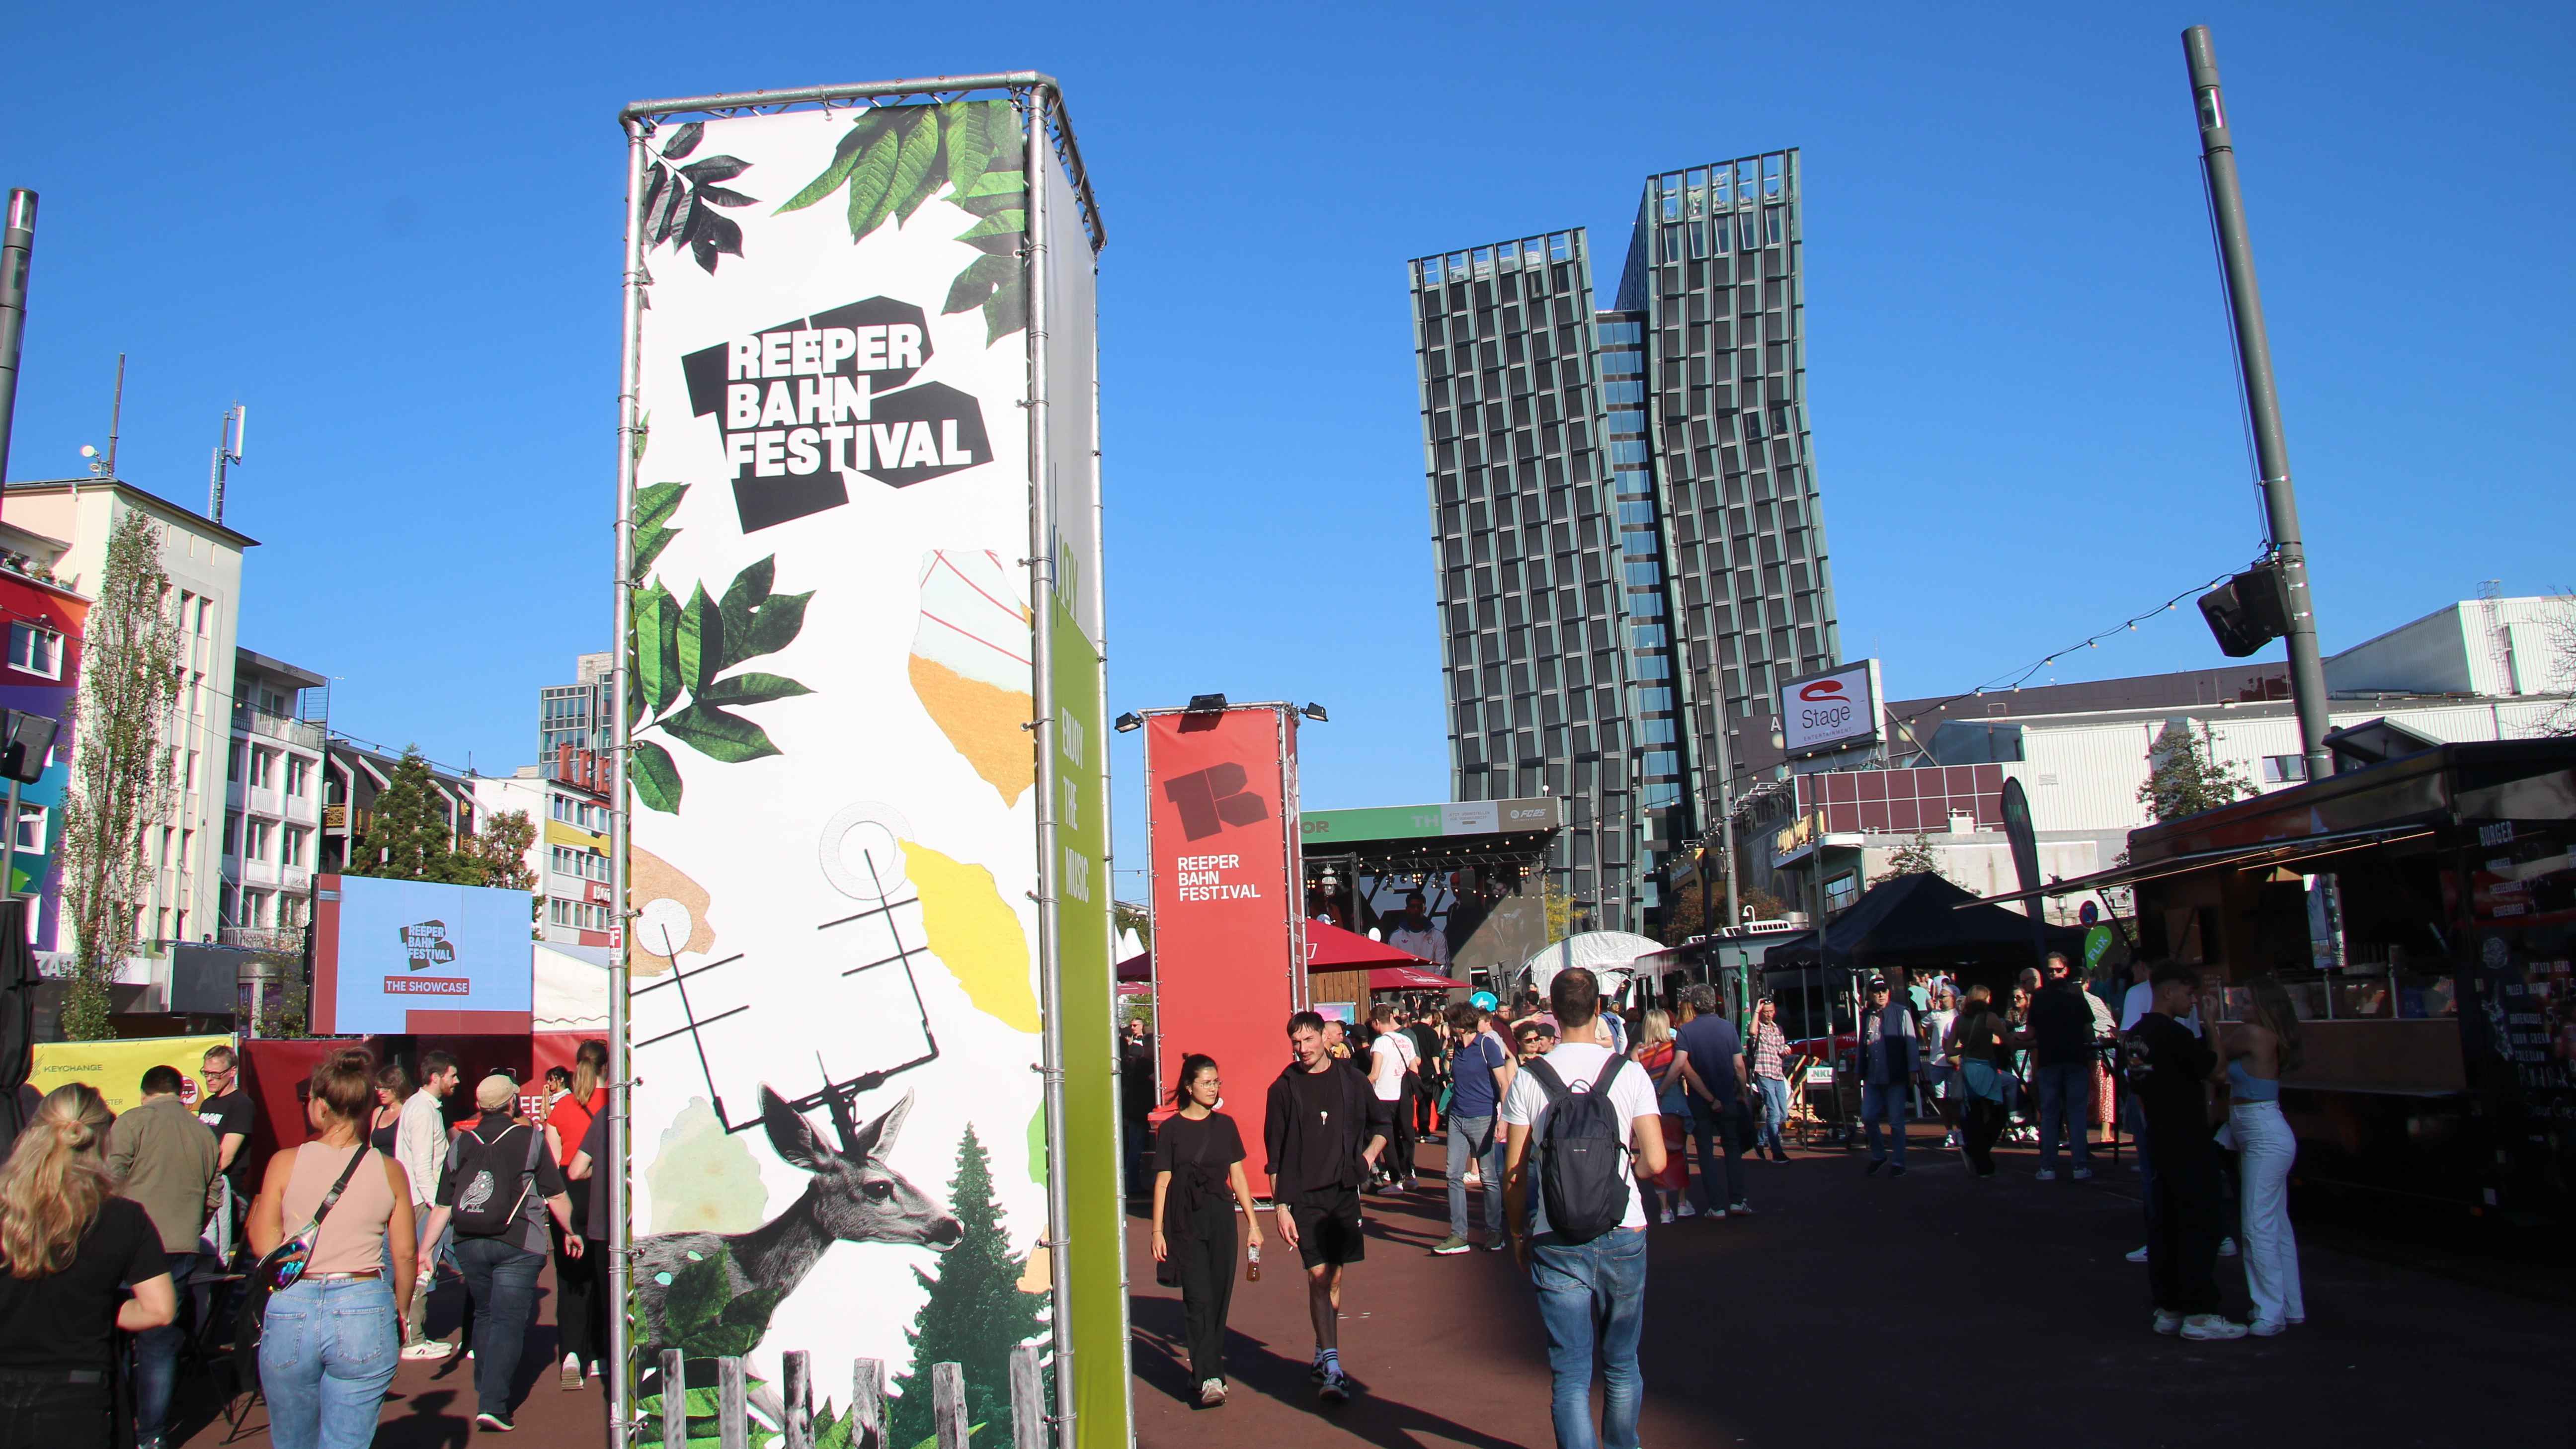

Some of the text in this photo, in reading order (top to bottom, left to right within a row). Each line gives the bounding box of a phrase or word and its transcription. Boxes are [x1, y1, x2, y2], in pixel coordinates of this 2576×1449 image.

[727, 323, 923, 380] REEPER
[726, 375, 871, 430] BAHN
[726, 419, 972, 479] FESTIVAL
[1802, 706, 1851, 728] Stage
[1061, 706, 1084, 770] ENJOY
[1804, 726, 1852, 741] ENTERTAINMENT
[1063, 775, 1078, 830] THE
[2479, 821, 2513, 847] BURGER
[1177, 854, 1239, 872] REEPER
[1065, 846, 1089, 904] MUSIC
[1178, 871, 1219, 887] BAHN
[1179, 884, 1261, 902] FESTIVAL
[408, 925, 445, 938] REEPER
[407, 937, 435, 949] BAHN
[407, 948, 452, 962] FESTIVAL
[386, 980, 468, 993] THE SHOWCASE
[44, 1064, 103, 1072] KEYCHANGE
